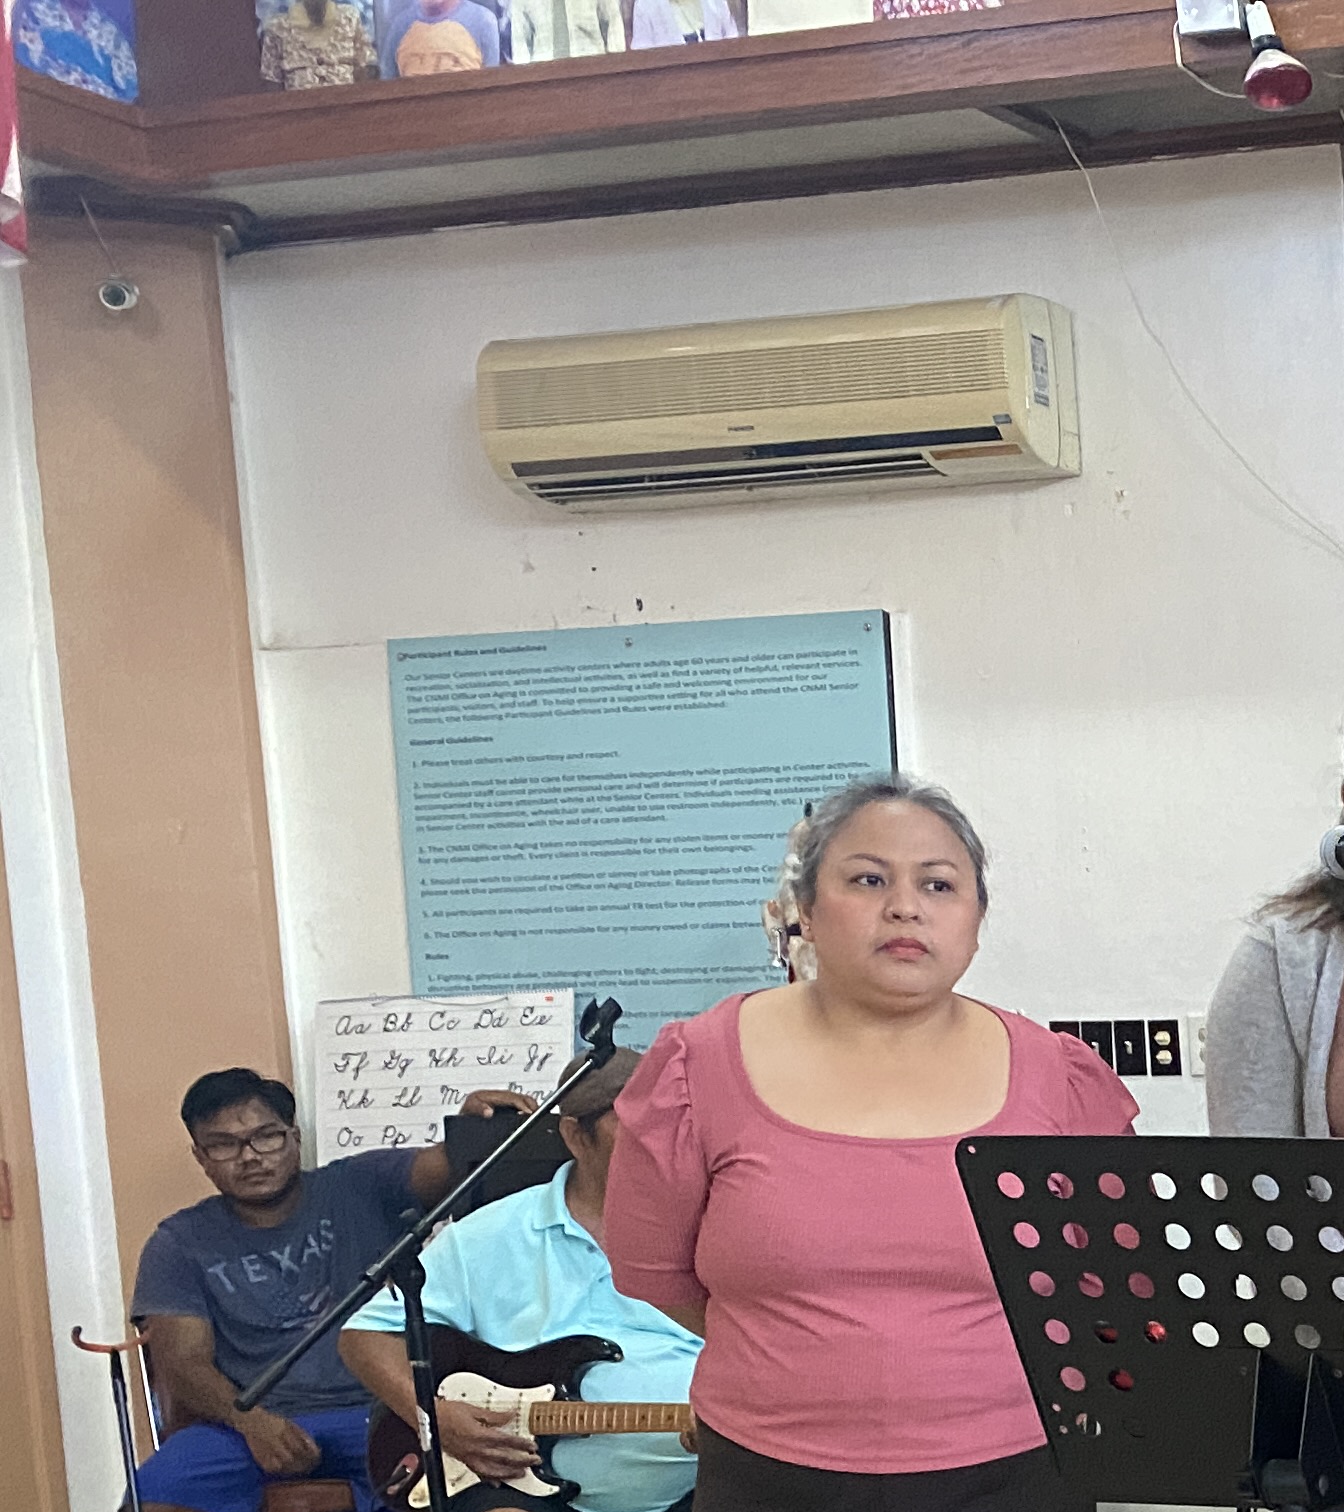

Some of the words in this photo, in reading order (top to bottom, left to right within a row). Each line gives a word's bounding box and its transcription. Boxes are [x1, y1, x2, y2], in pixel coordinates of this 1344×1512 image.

[335, 1014, 371, 1036] Aa
[382, 1012, 413, 1033] Bb
[428, 1010, 461, 1032] Cc
[473, 1008, 510, 1031] Dd
[519, 1006, 553, 1027] Ee
[333, 1051, 369, 1080] Ff
[383, 1049, 415, 1079] Gg
[428, 1047, 465, 1069] Hh
[476, 1045, 514, 1066] Ii
[523, 1043, 554, 1072] Jj
[337, 1088, 374, 1110] Kk
[391, 1085, 423, 1109] Ll
[440, 1084, 467, 1105] M
[337, 1126, 364, 1148] Oo
[381, 1124, 412, 1147] Pp
[207, 1219, 334, 1294] TEXAS
